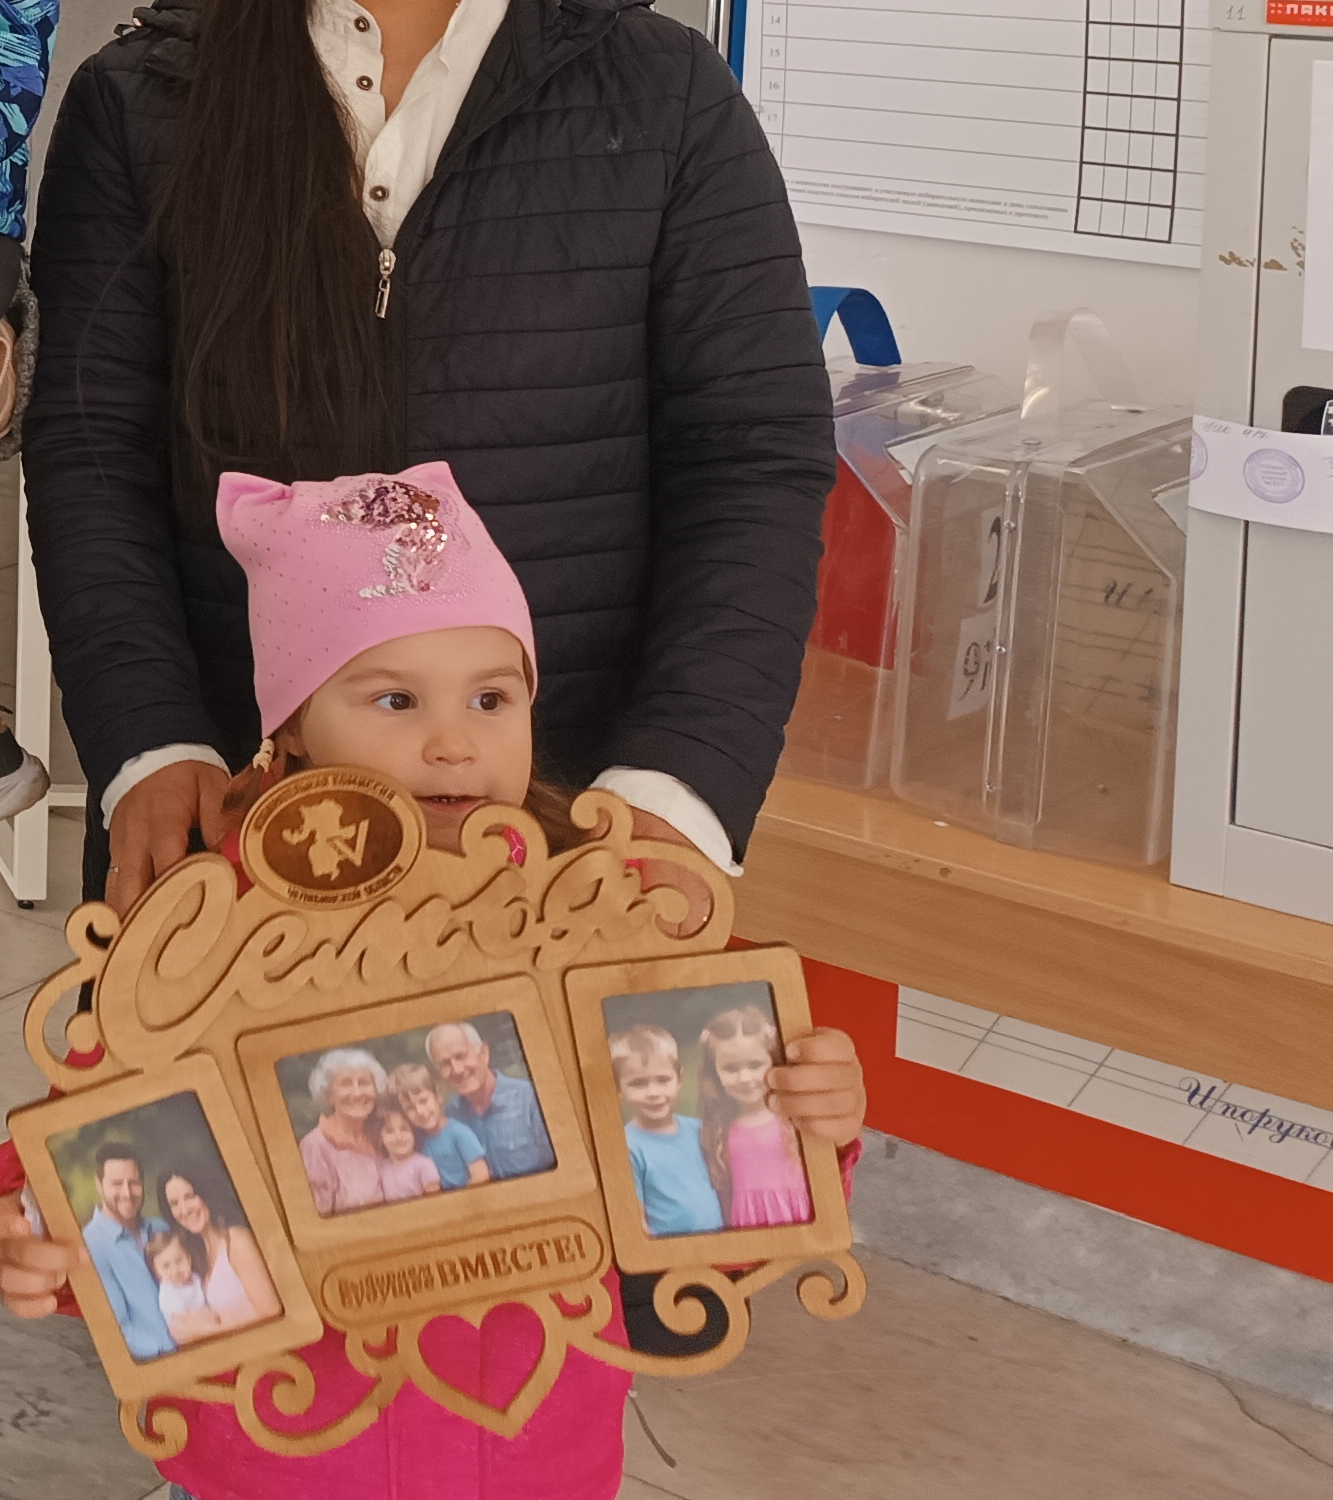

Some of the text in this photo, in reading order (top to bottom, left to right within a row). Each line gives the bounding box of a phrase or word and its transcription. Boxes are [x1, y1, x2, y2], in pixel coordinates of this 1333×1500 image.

[770, 15, 781, 25] 14
[769, 47, 780, 58] 15
[768, 80, 780, 91] 16
[767, 113, 779, 124] 17
[98, 845, 653, 1056] Семья
[1178, 1076, 1333, 1151] И поруко
[436, 1232, 587, 1290] ВМЕСТЕ!
